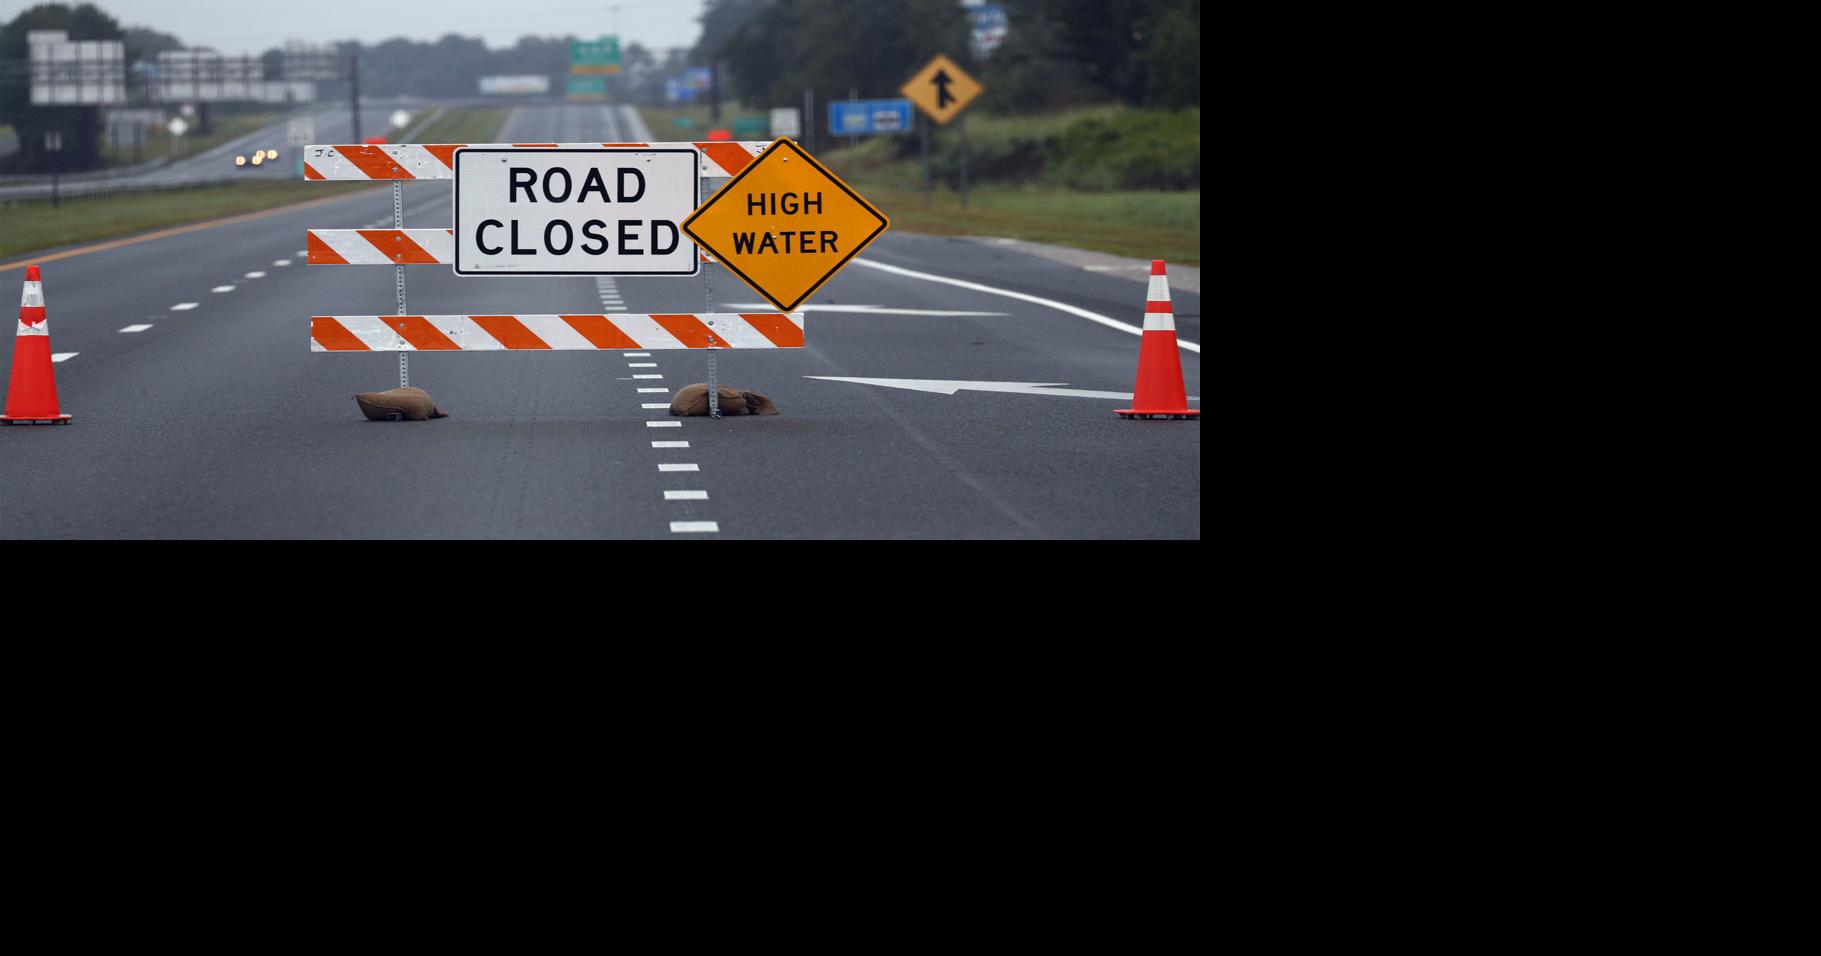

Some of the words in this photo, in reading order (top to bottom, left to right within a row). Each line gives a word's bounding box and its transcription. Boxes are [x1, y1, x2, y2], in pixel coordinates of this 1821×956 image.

[509, 166, 646, 203] ROAD
[747, 192, 823, 216] HIGH
[475, 219, 680, 256] CLOSED
[733, 231, 839, 255] WATER
